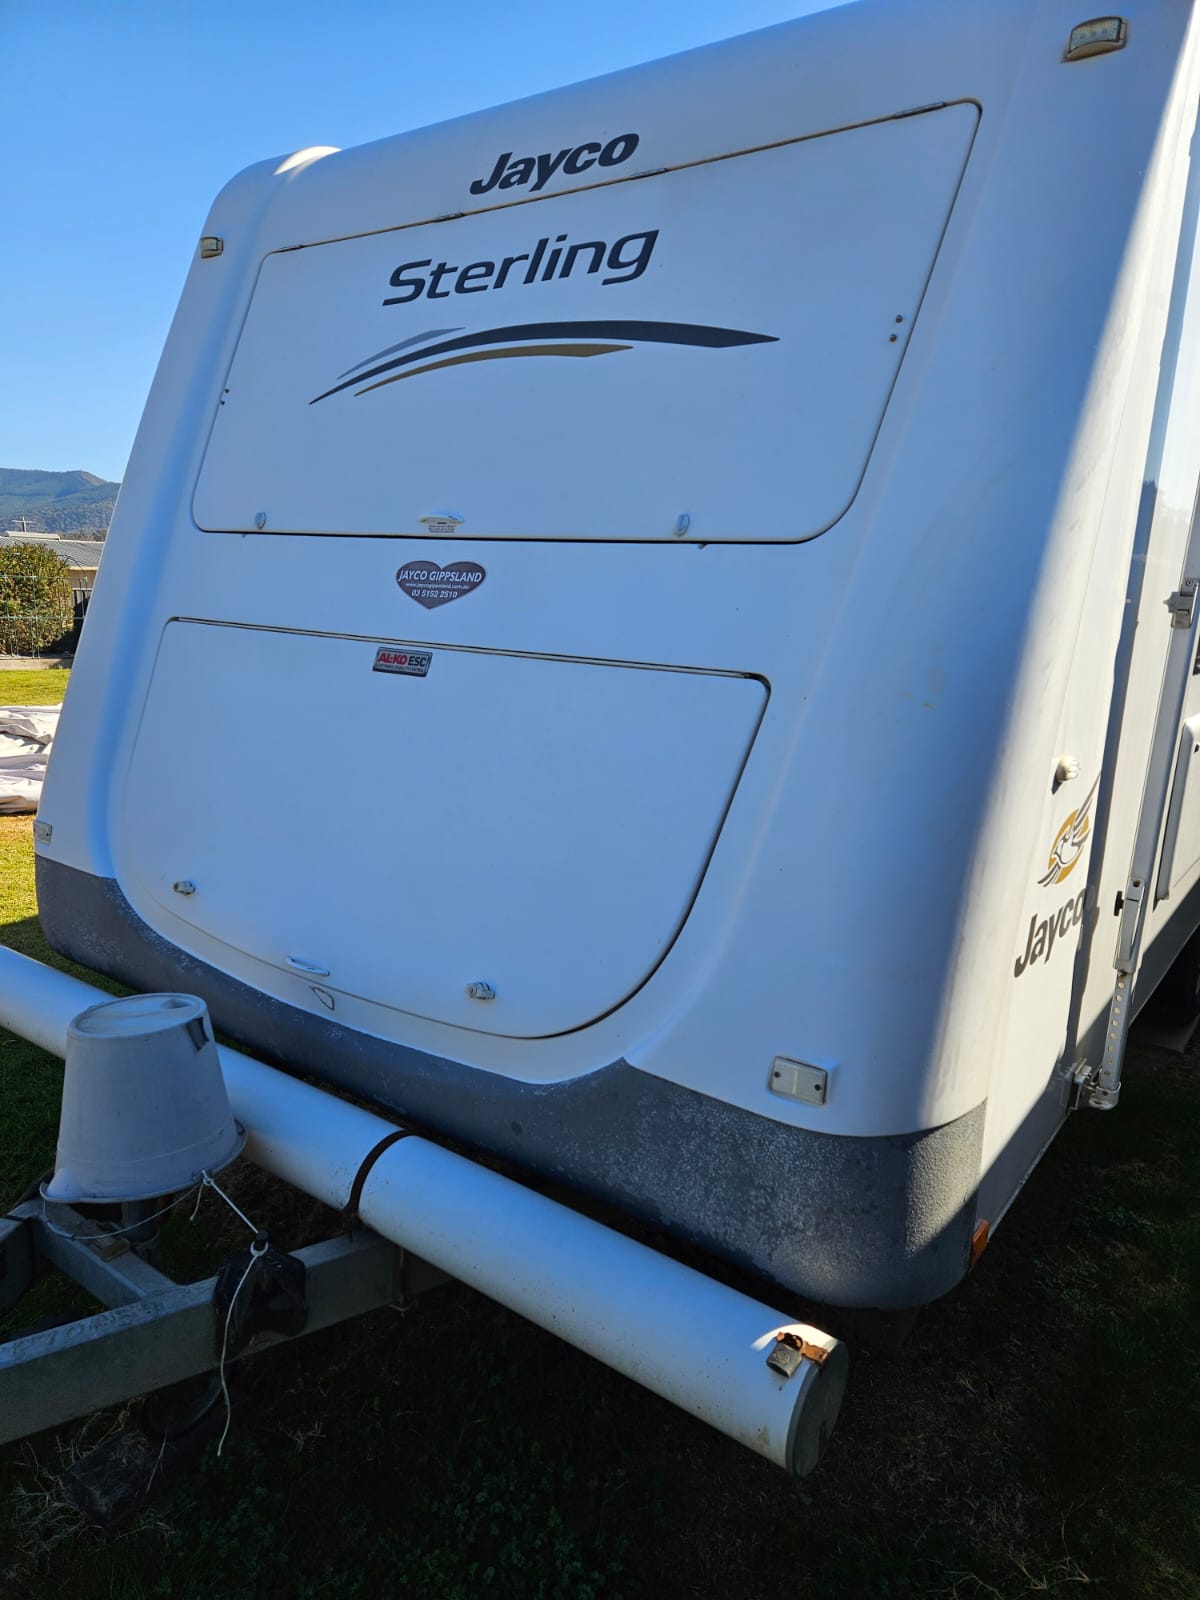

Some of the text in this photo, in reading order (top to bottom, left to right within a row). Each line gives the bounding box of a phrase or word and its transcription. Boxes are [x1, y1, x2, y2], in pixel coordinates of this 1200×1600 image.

[470, 133, 640, 195] Jayco
[382, 229, 660, 307] Sterling
[398, 570, 482, 583] JAYCO GIPPSLAND
[411, 589, 420, 597] 03
[440, 590, 458, 598] 2510
[408, 655, 427, 667] ESC
[1014, 887, 1088, 978] Jayco
